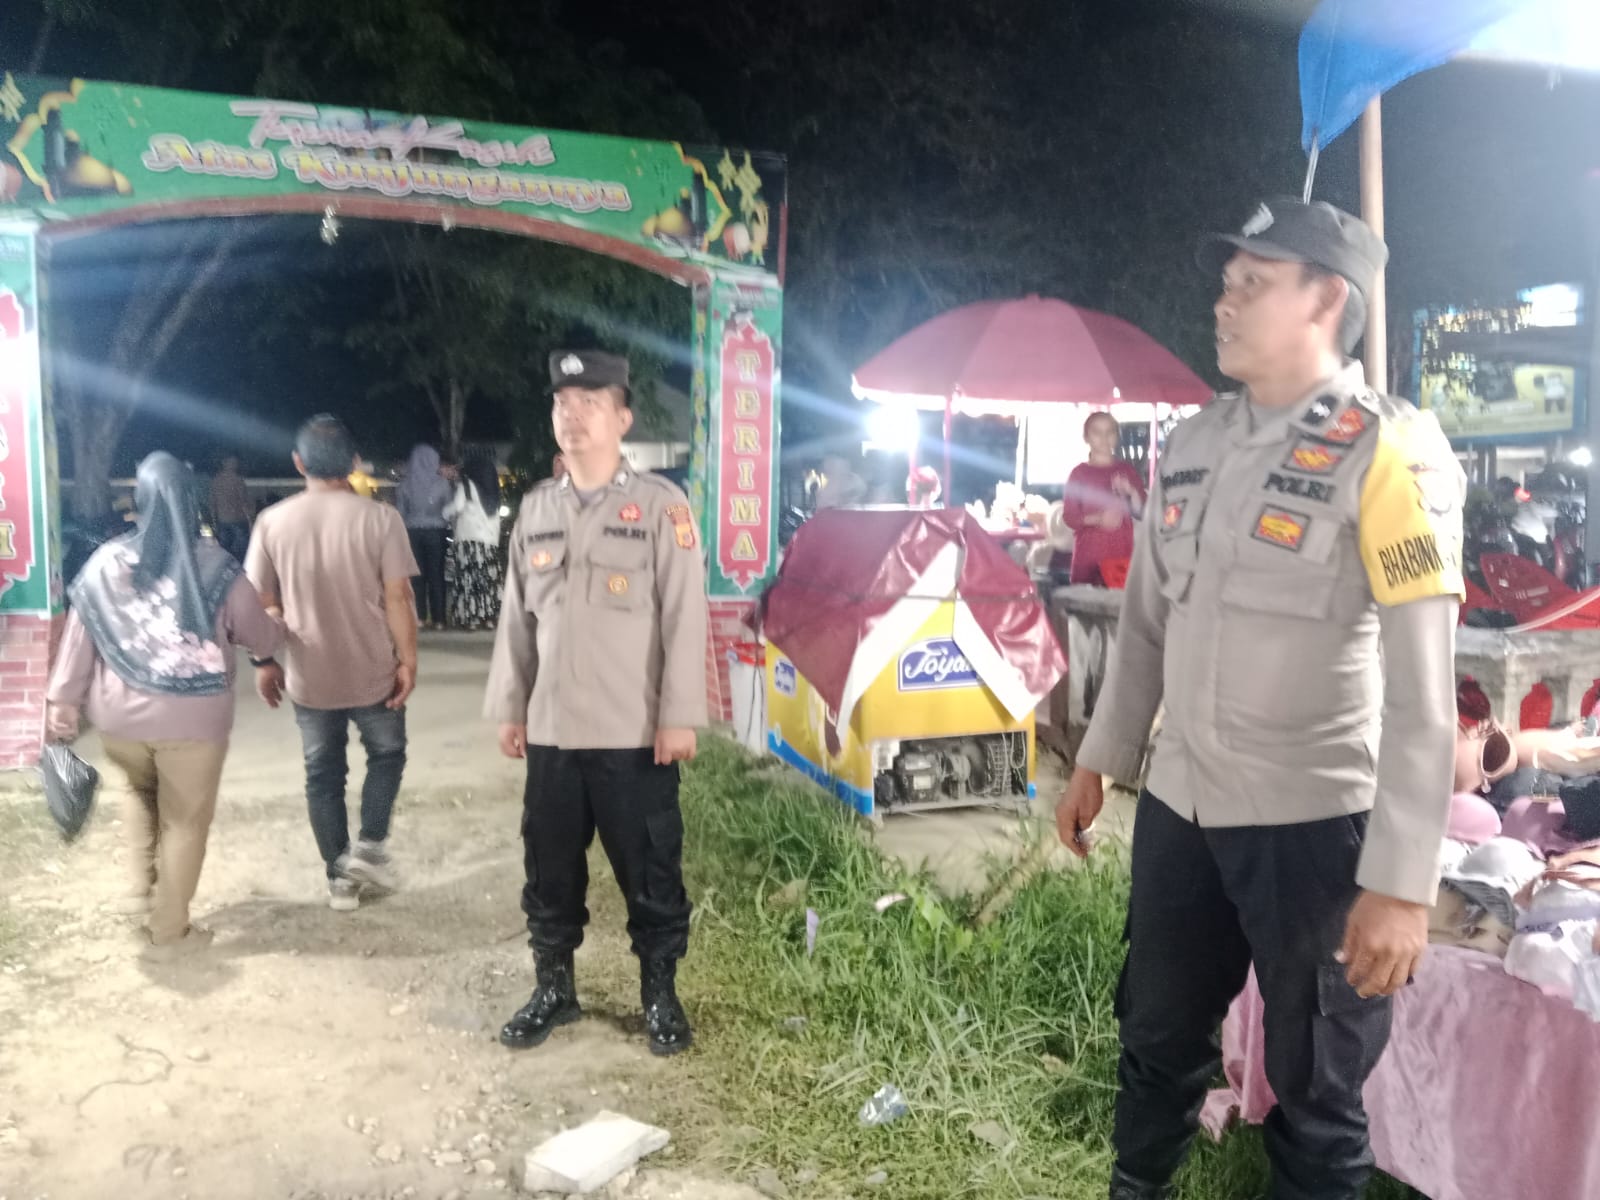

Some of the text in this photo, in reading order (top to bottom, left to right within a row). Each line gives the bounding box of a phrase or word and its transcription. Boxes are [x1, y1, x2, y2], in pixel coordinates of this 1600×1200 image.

[730, 350, 762, 561] TERIMA
[1263, 472, 1337, 504] POLRI
[1379, 533, 1447, 588] BHABINK
